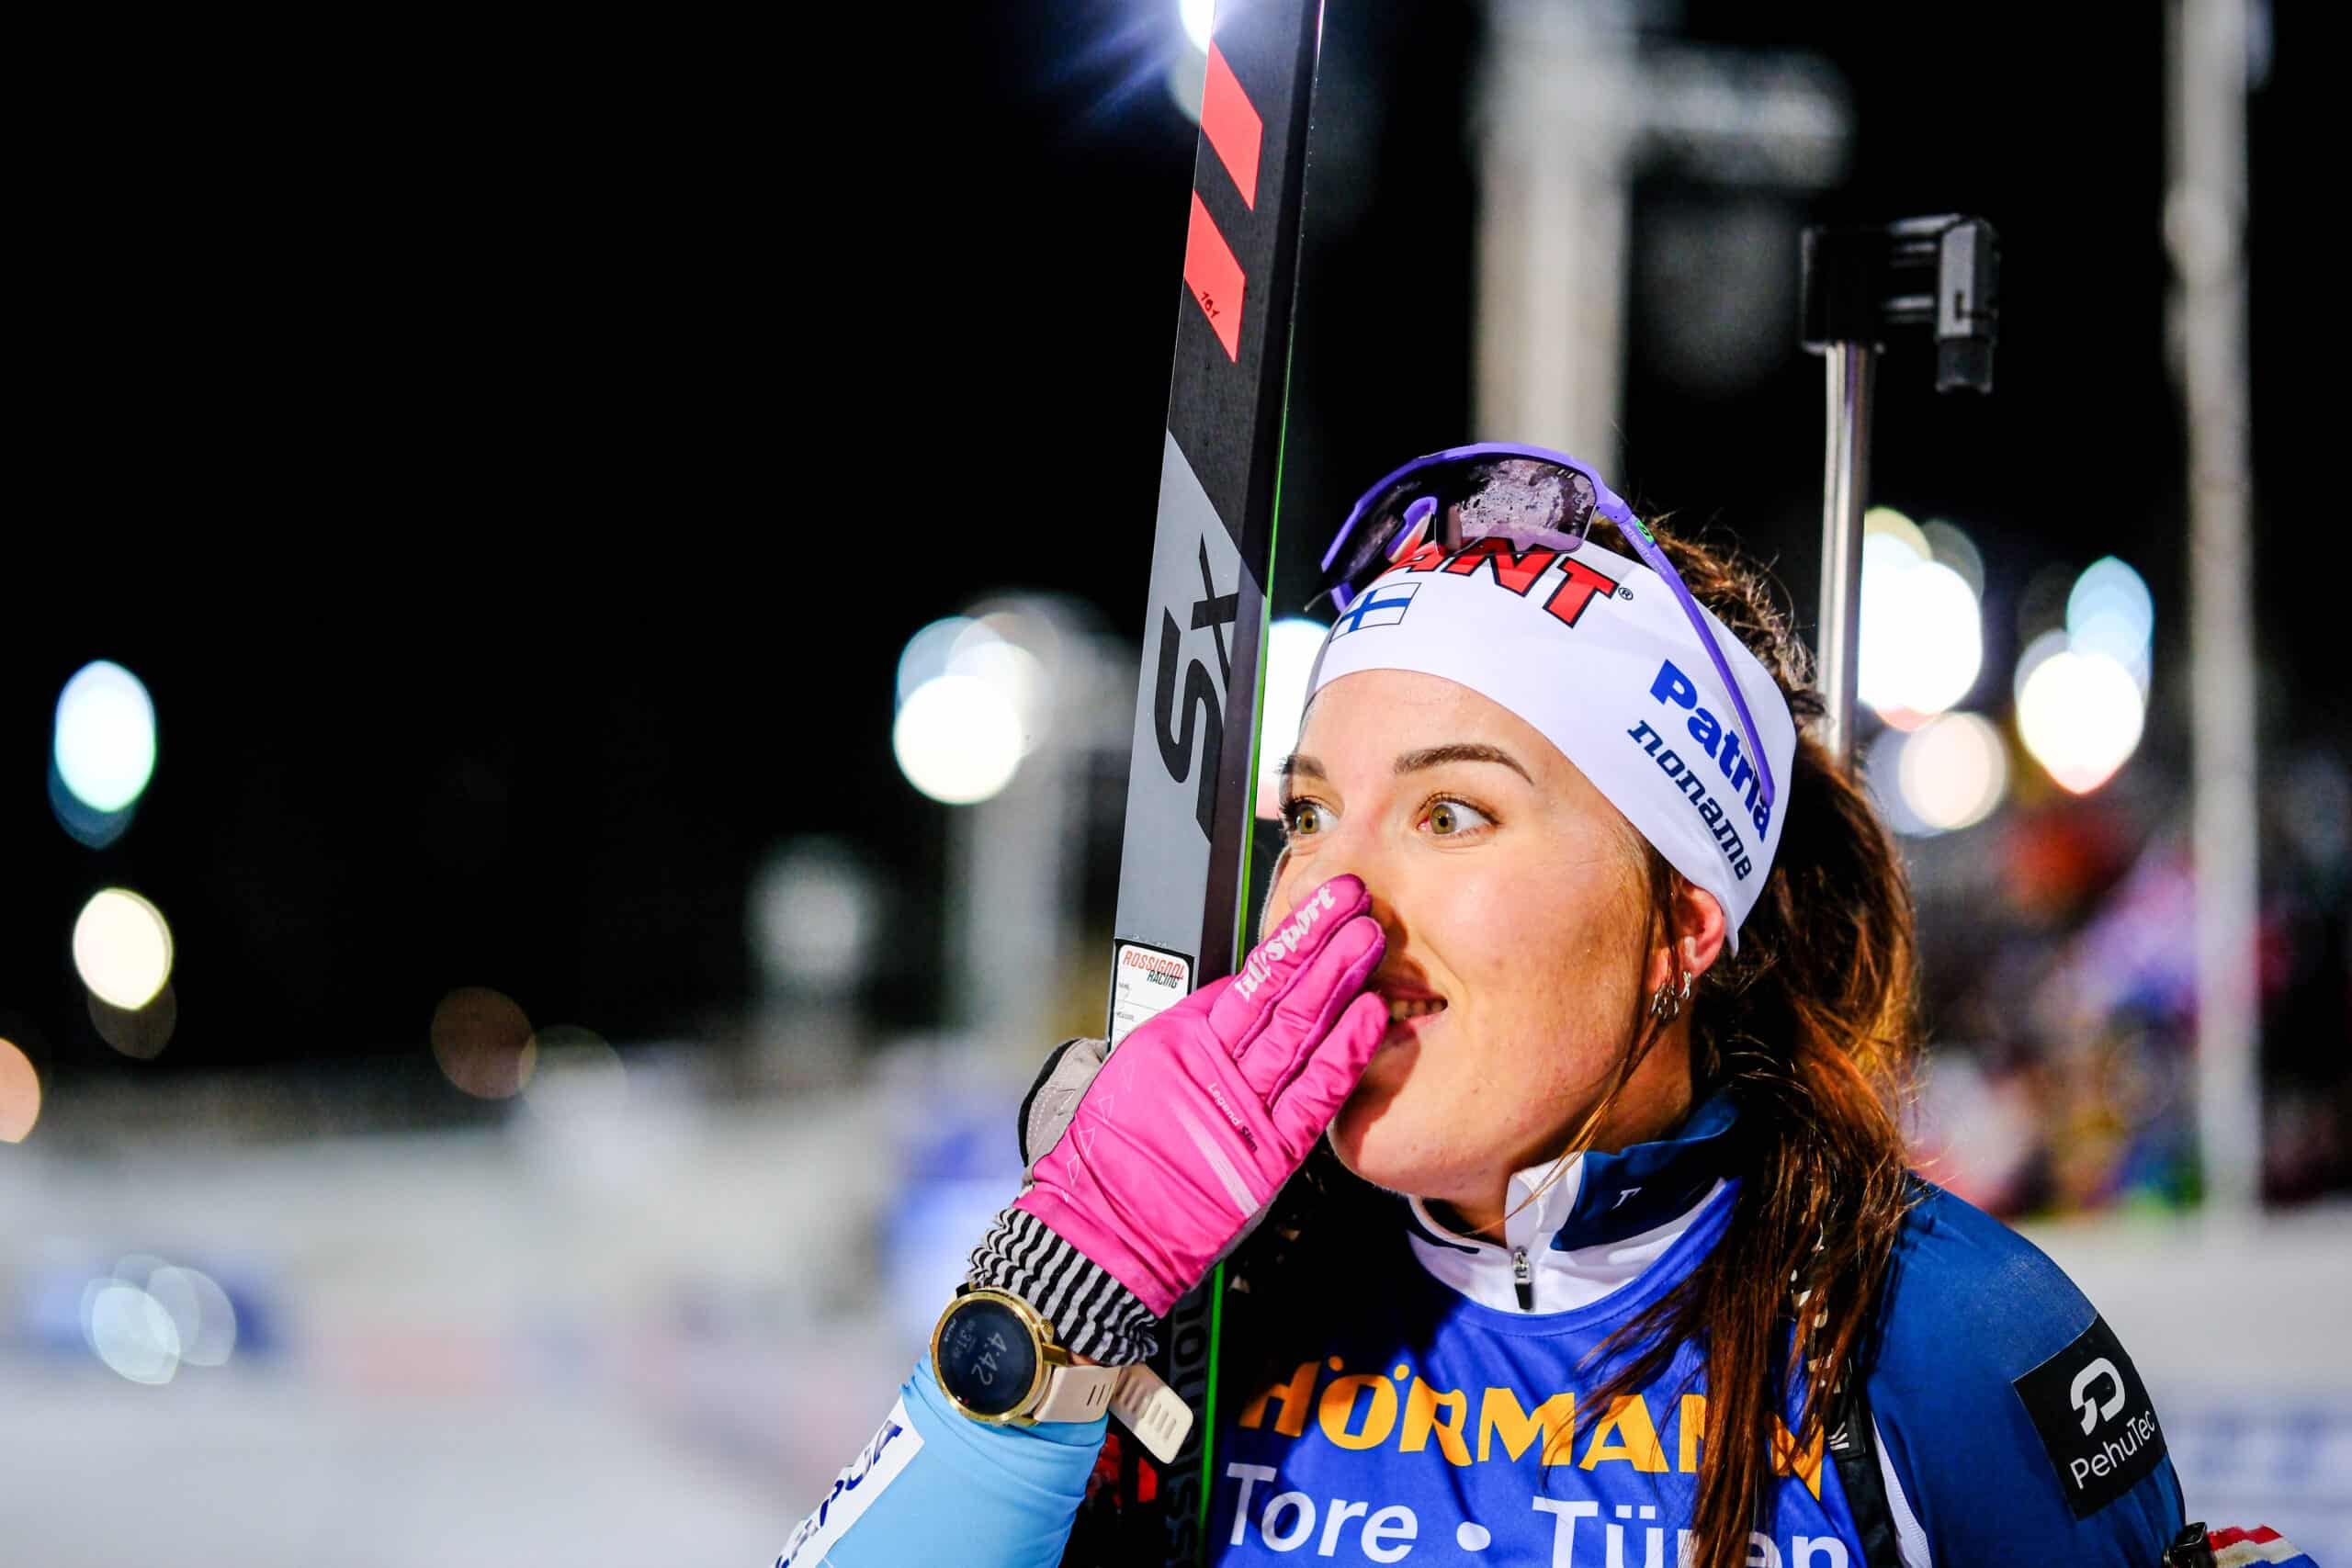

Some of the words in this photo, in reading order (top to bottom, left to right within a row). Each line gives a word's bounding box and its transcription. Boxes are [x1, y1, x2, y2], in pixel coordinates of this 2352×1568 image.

[1627, 720, 1753, 881] noname
[1207, 1082, 1243, 1126] Legend
[1240, 1126, 1258, 1153] Slim
[2069, 1411, 2155, 1490] PehuTec
[1226, 1463, 1419, 1559] Tore
